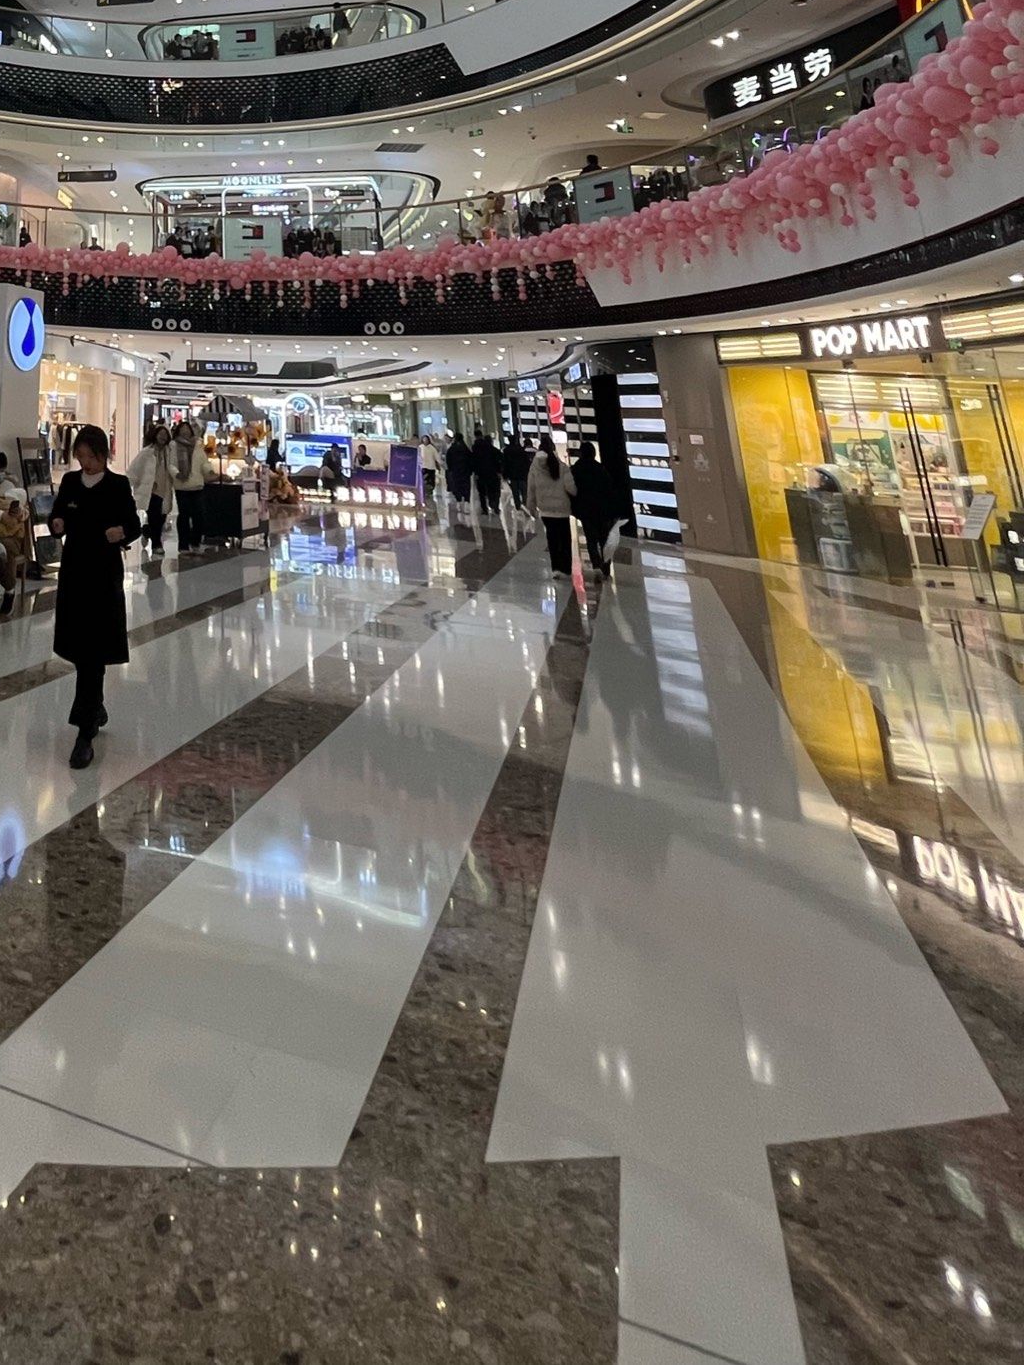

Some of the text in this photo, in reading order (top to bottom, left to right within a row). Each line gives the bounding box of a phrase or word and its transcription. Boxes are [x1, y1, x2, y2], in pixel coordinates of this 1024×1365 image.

[732, 47, 833, 108] 麦当劳
[223, 175, 282, 186] MOONLENS
[811, 316, 930, 357] POP MART
